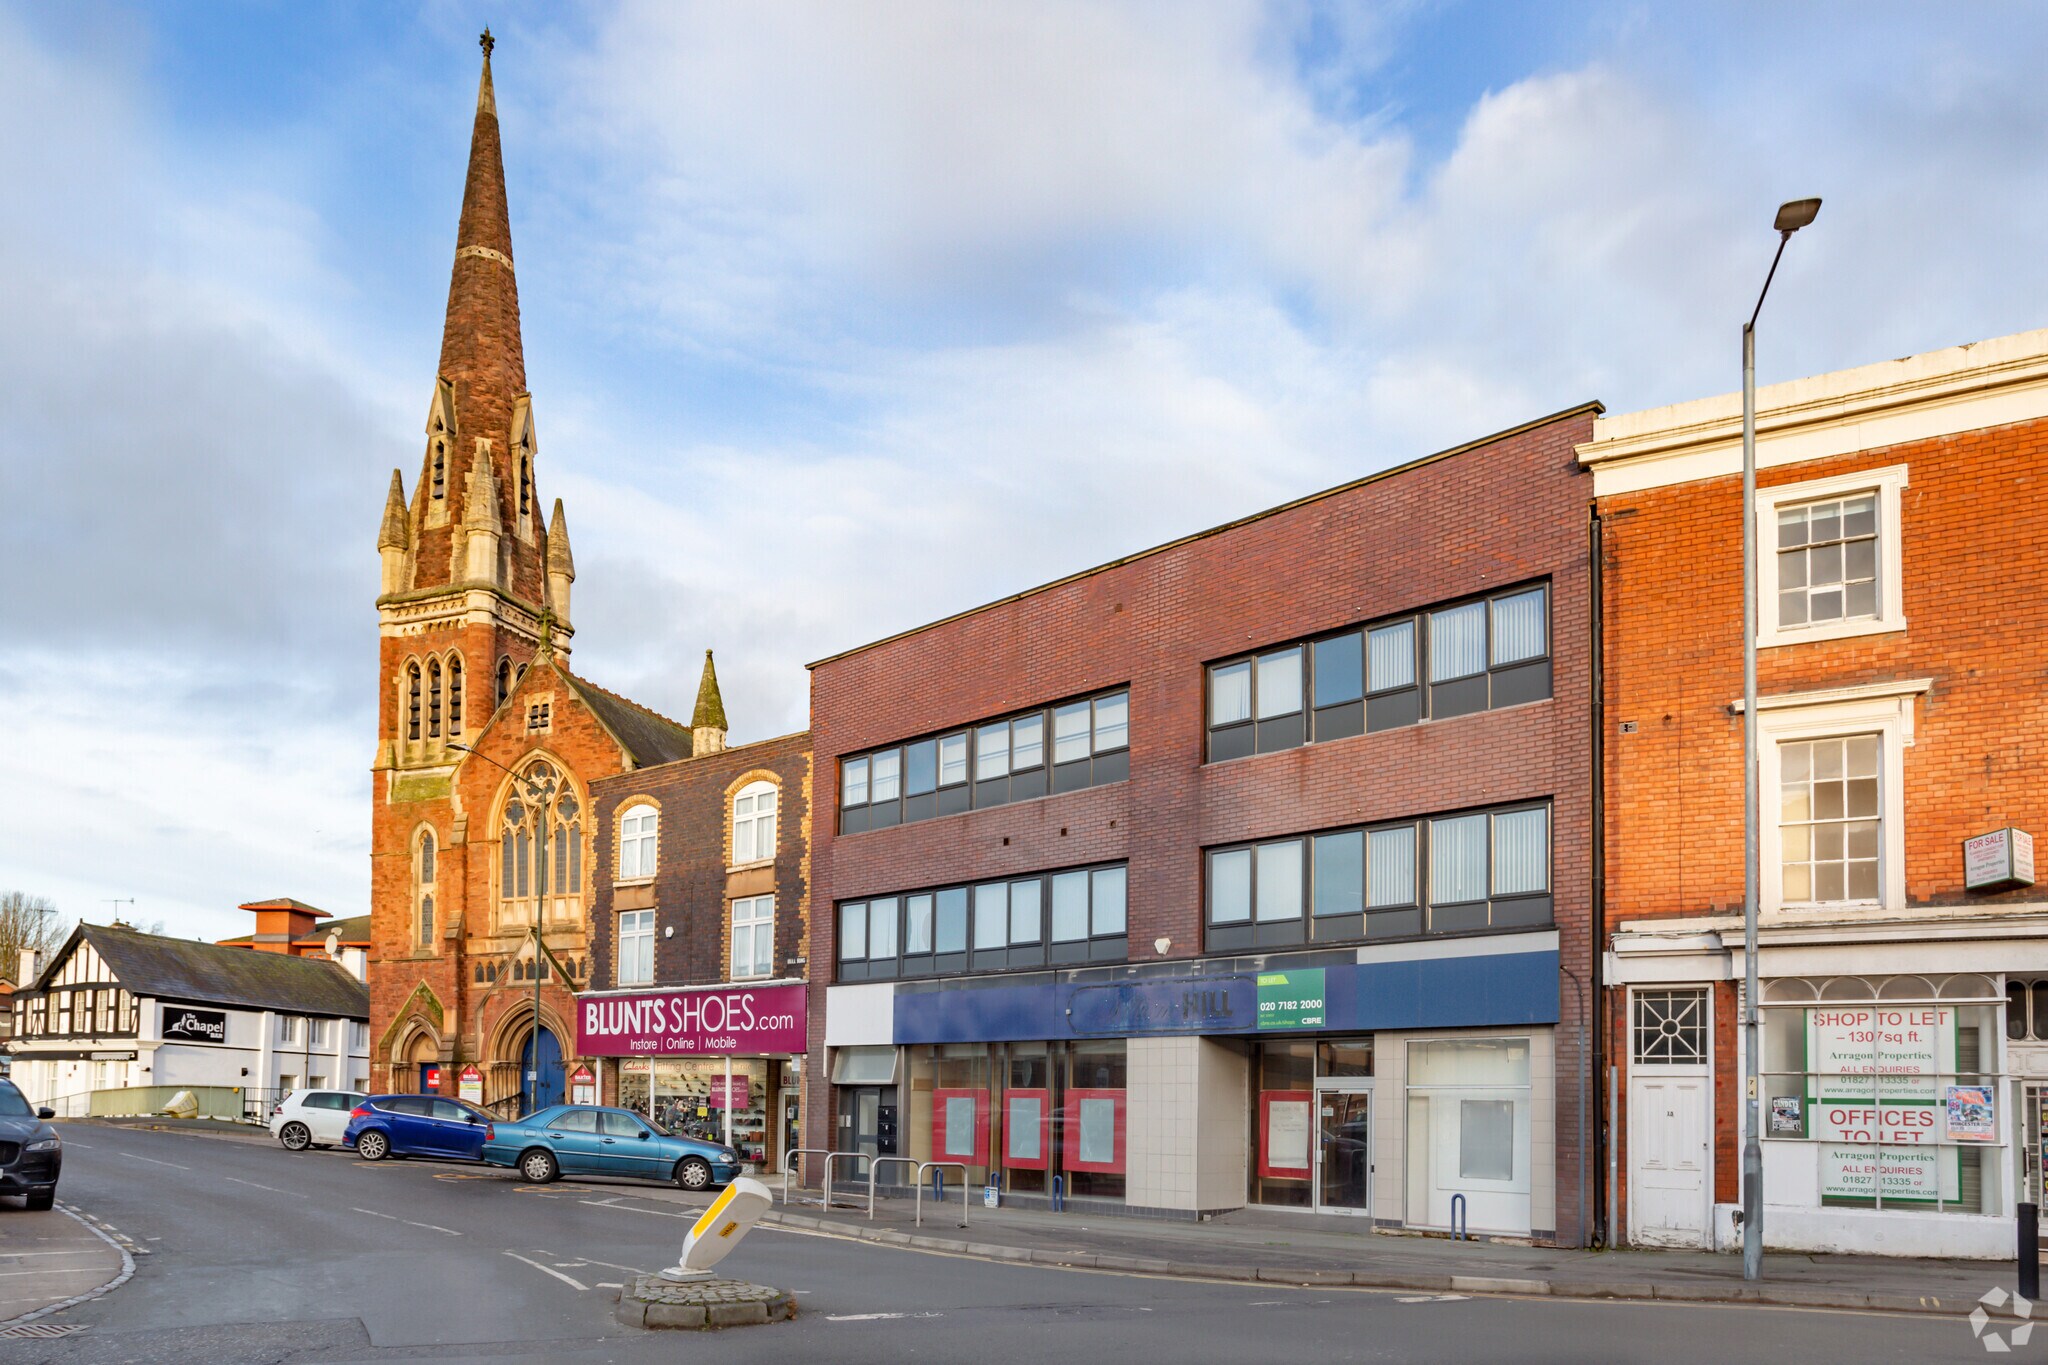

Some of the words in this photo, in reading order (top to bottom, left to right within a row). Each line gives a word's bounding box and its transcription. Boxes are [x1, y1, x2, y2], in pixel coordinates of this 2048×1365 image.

[1968, 839, 1984, 851] FOR
[1985, 833, 2004, 846] SALE
[1183, 991, 1232, 1020] HILL
[1260, 1002, 1275, 1011] 020
[1278, 1001, 1297, 1010] 7182
[1300, 999, 1323, 1009] 2000
[586, 999, 666, 1035] BLUNTS
[1301, 1017, 1322, 1025] CBRE
[1814, 1013, 1869, 1026] SHOP
[1877, 1012, 1903, 1026] TO
[1909, 1012, 1948, 1026] LET
[186, 1019, 224, 1034] Chapel
[630, 1039, 658, 1050] Instore
[666, 1038, 695, 1050] Online
[705, 1036, 737, 1049] Mobile
[1908, 1031, 1922, 1042] ft.
[1830, 1052, 1873, 1061] Arragon
[1878, 1051, 1932, 1061] Properties
[623, 1060, 650, 1071] Clarks
[656, 1062, 681, 1072] Fitting
[684, 1062, 715, 1071] Centre
[1829, 1109, 1934, 1127] OFFICES
[1839, 1130, 1872, 1146] TO
[1879, 1131, 1924, 1147] LET
[1831, 1151, 1875, 1161] Arragon
[1879, 1152, 1935, 1163] Properties
[1842, 1165, 1861, 1173] ALL
[1864, 1165, 1923, 1175] ENQUIRIES
[1842, 1176, 1872, 1184] 01827
